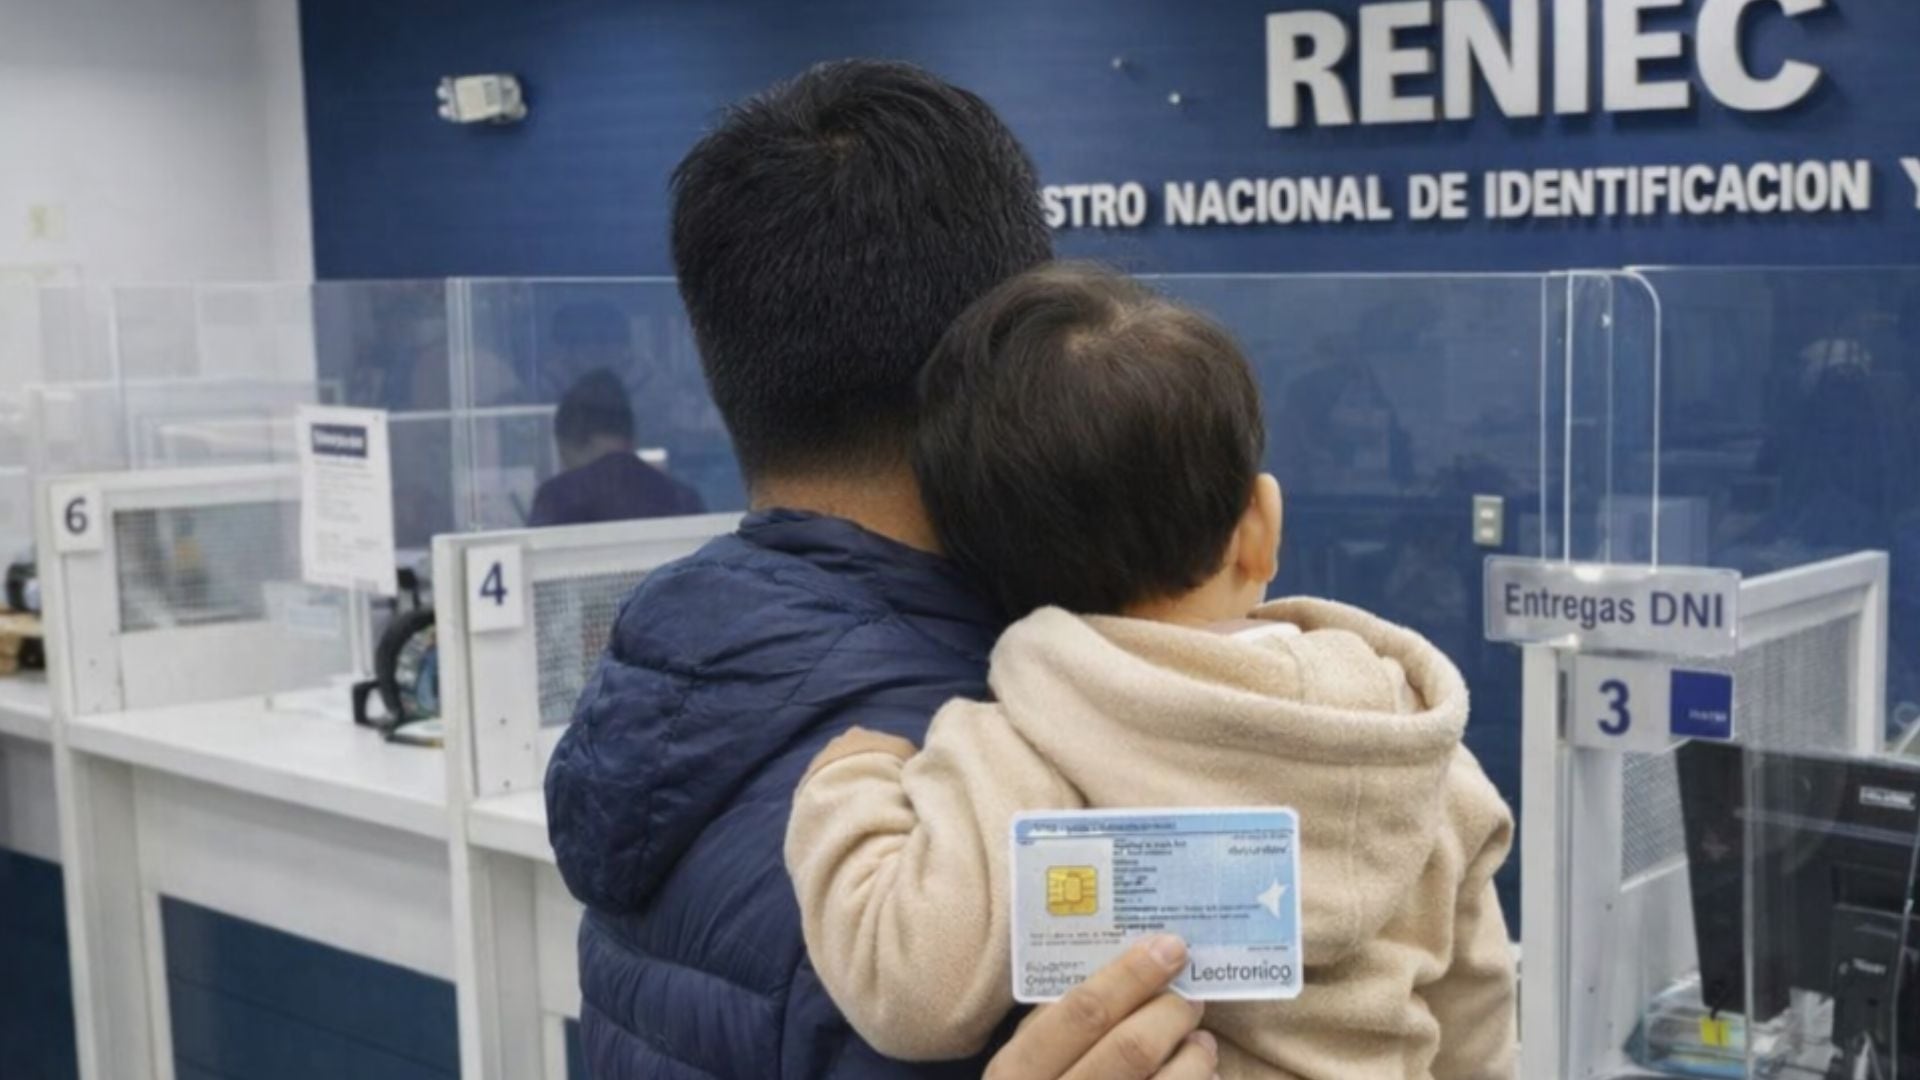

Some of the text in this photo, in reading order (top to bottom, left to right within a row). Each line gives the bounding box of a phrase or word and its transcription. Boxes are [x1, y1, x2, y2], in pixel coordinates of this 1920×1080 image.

[1266, 0, 1822, 128] RENIEC
[1164, 176, 1391, 225] NACIONAL
[1409, 172, 1468, 219] DE
[1484, 160, 1870, 217] IDENTIFICACION
[64, 496, 88, 535] 6
[479, 561, 508, 606] 4
[1504, 583, 1723, 630] Entregas DNI
[1597, 678, 1631, 737] 3
